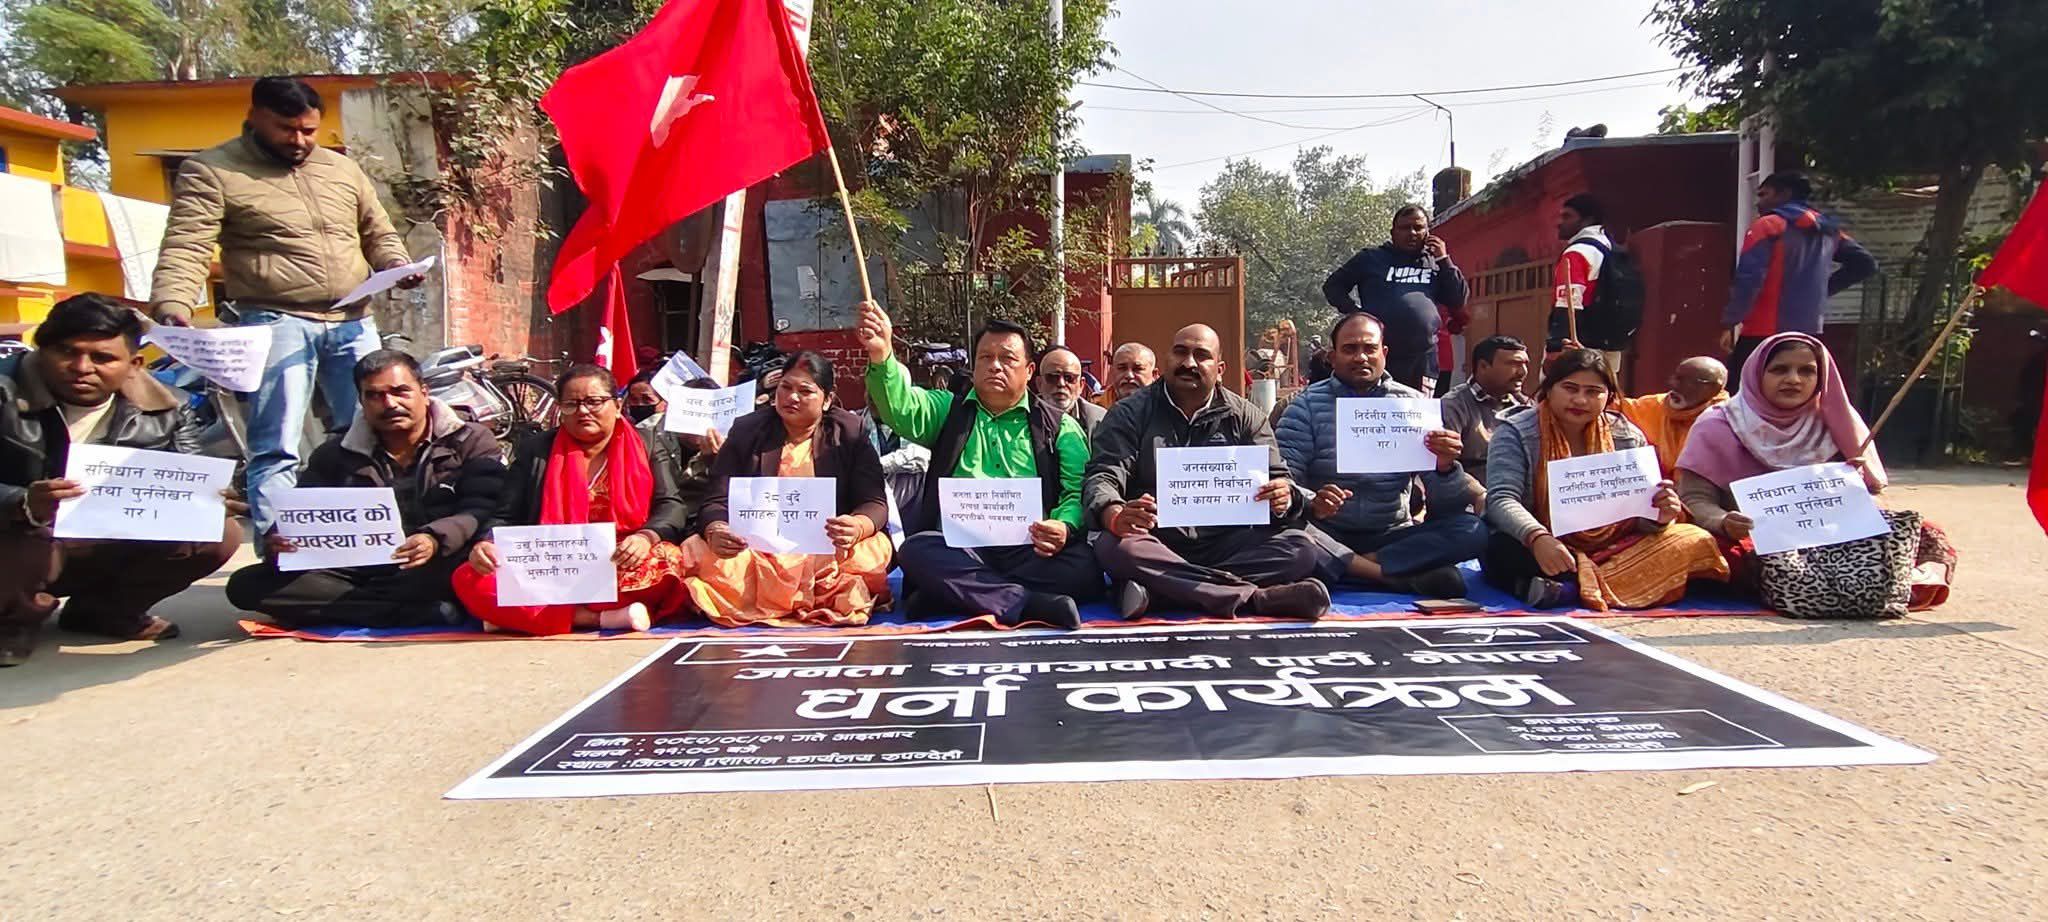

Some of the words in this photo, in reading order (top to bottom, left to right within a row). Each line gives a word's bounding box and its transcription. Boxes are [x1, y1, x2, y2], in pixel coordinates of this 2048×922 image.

[1386, 266, 1432, 284] NIKE
[1351, 424, 1386, 438] चुनावको
[1377, 440, 1390, 449] गर
[1168, 479, 1209, 490] आधारमा
[1213, 475, 1252, 489] निर्वाचन
[91, 485, 122, 498] तथा
[1171, 493, 1188, 505] क्षेत्र
[1193, 495, 1222, 505] कायम
[1227, 494, 1240, 503] गर
[122, 506, 145, 519] गर
[278, 507, 357, 524] मलखाद
[363, 503, 392, 521] को
[781, 509, 800, 523] पुरा
[805, 509, 819, 520] गर
[1763, 504, 1789, 517] तथा
[1795, 518, 1815, 530] गर
[363, 532, 396, 546] गर
[733, 663, 912, 680] जनता
[930, 653, 1233, 677] समाजवादी
[1403, 649, 1583, 664] नेपाल
[795, 673, 1028, 720] धर्ना
[1056, 667, 1577, 714] कार्यक्रम
[583, 737, 634, 748] मिति
[571, 749, 632, 758] समय
[556, 760, 618, 770] स्थान
